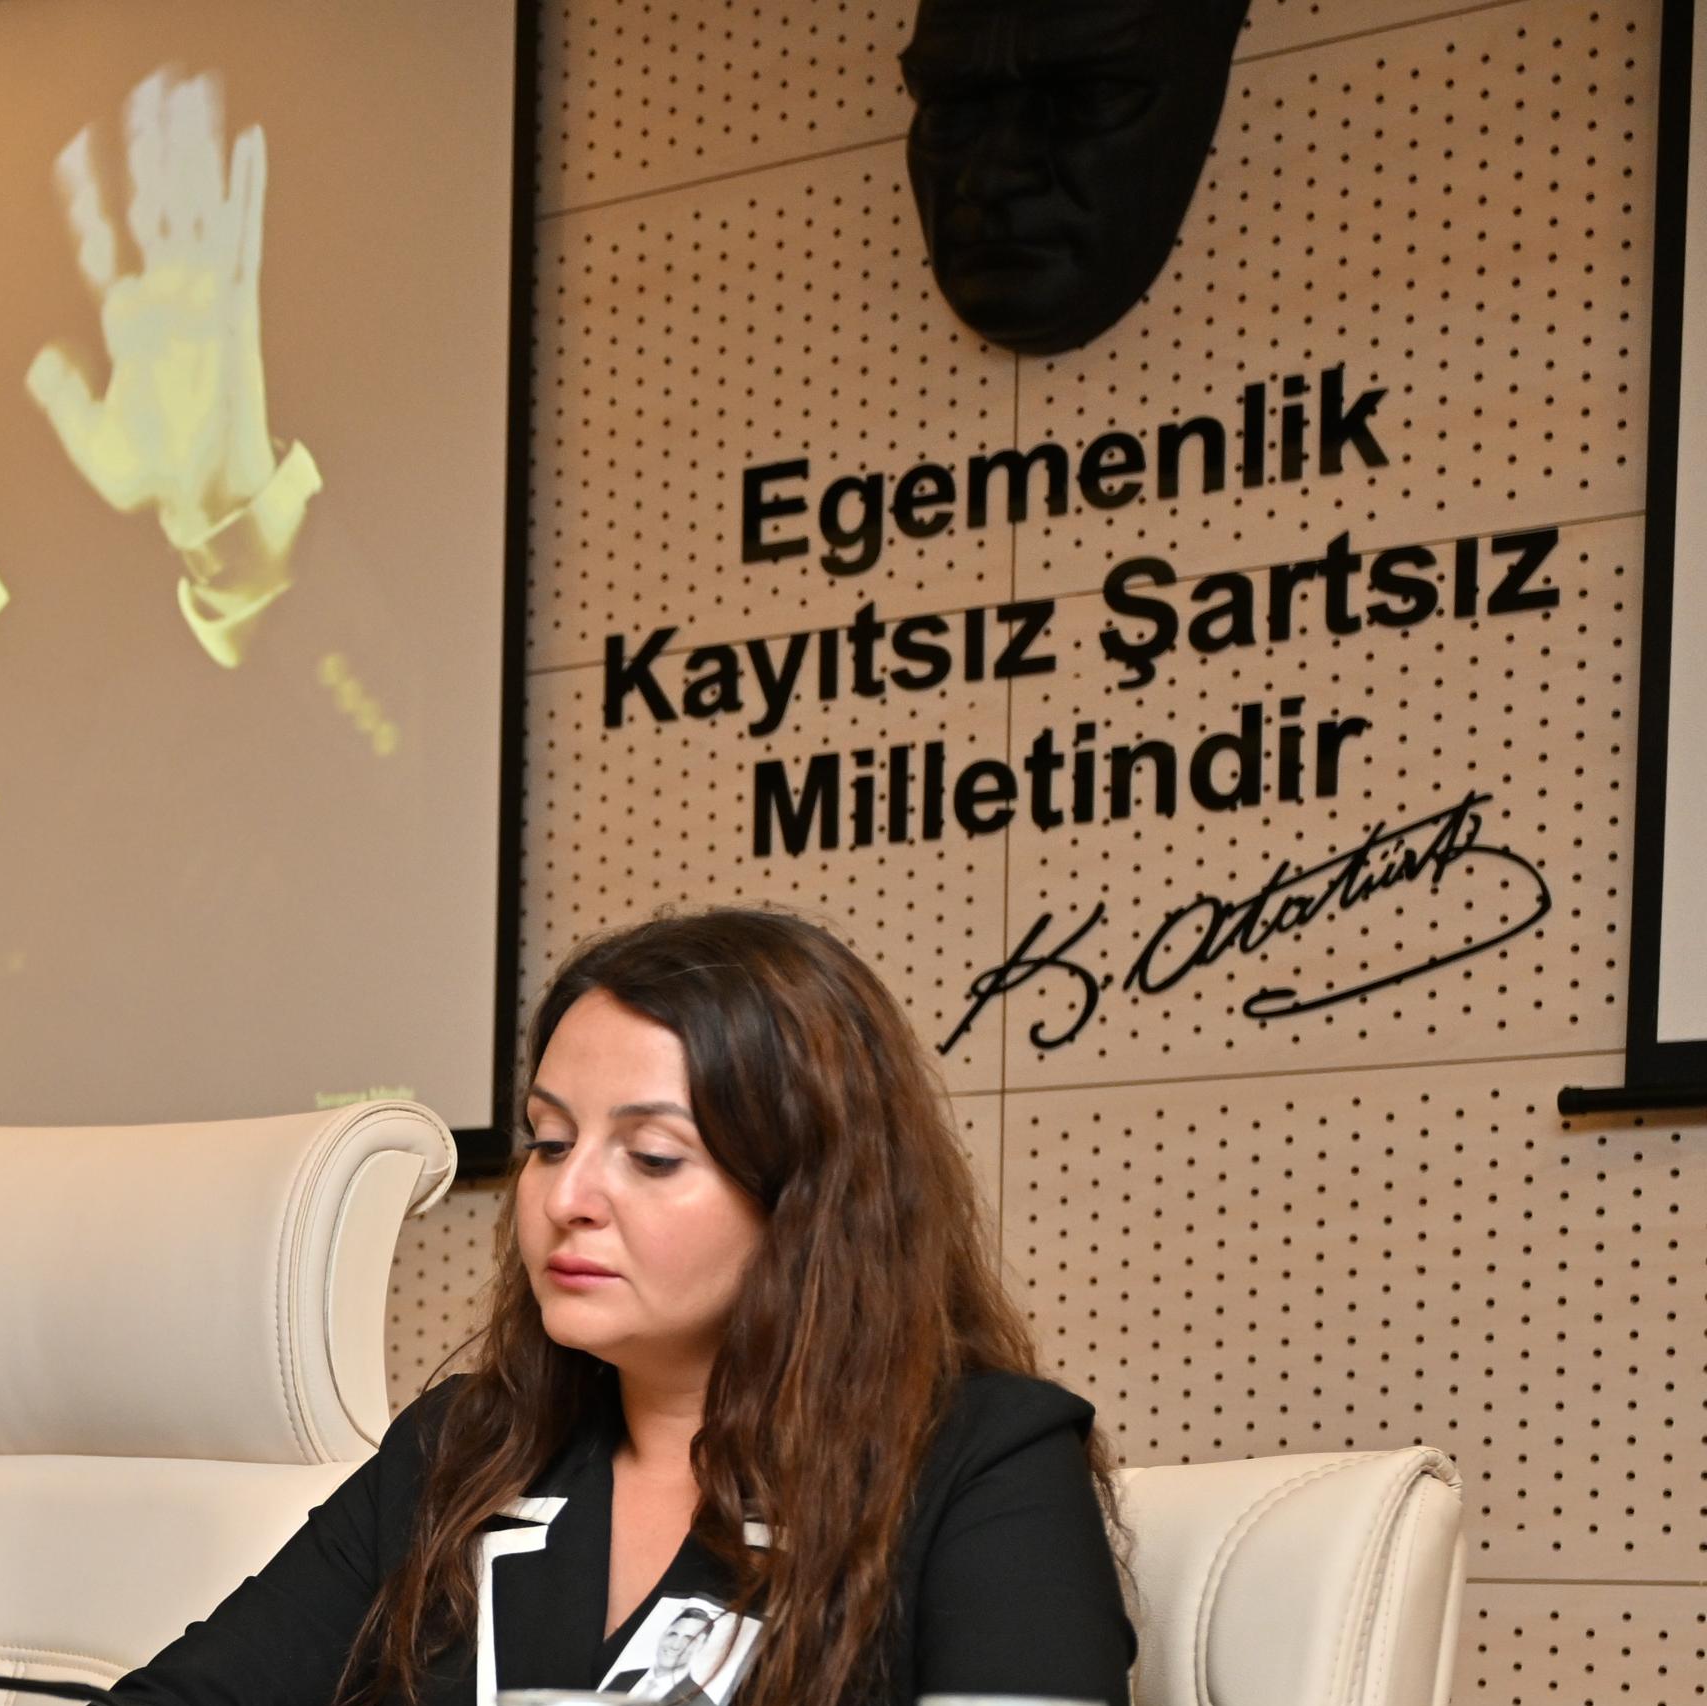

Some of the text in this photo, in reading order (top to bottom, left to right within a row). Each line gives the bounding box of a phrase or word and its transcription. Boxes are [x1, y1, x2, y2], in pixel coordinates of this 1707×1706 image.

[740, 360, 1390, 578] Egemenlik
[601, 525, 1561, 739] Kayıtsız Şartsız
[752, 696, 1374, 859] Milletindir
